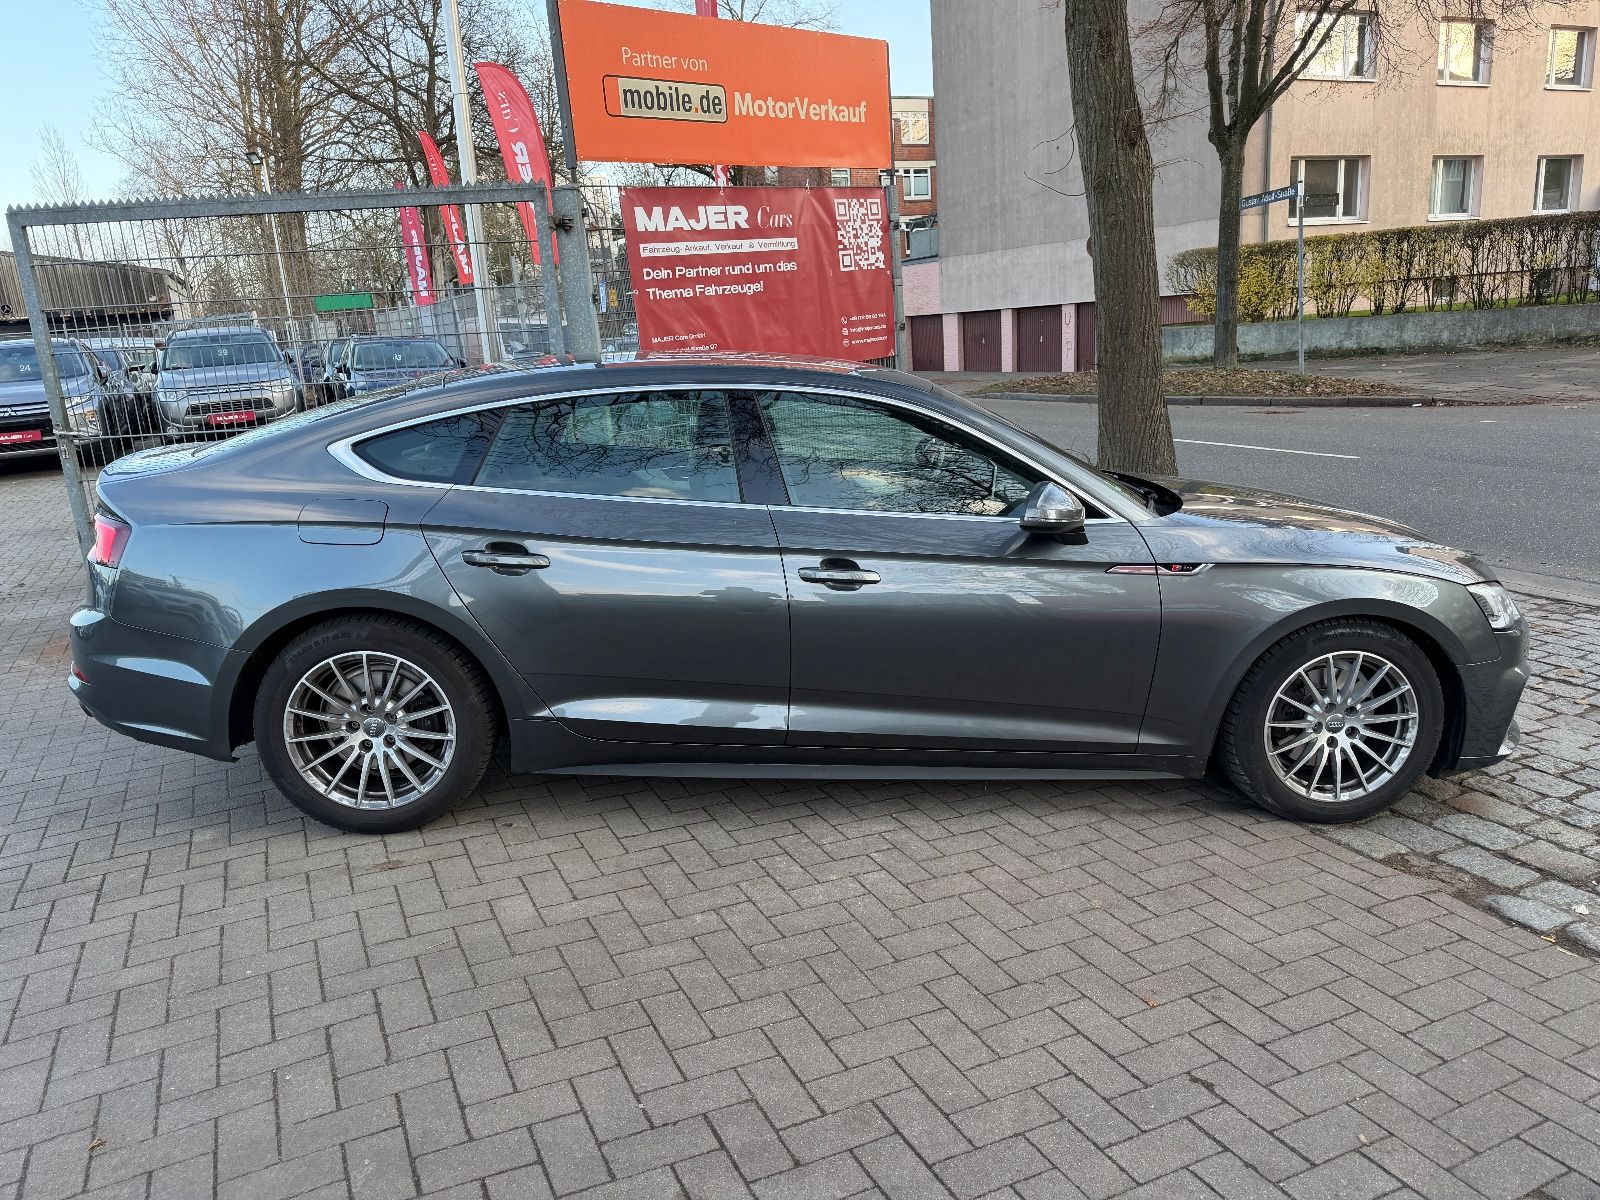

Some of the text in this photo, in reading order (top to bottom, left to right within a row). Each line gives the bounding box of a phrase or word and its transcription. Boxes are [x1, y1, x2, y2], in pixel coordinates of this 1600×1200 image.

[621, 47, 708, 72] Partner von
[623, 86, 867, 123] mobile.de MotorVerkauf
[634, 205, 793, 232] MAJER Cars
[714, 243, 743, 251] Verkauf
[642, 260, 797, 280] Dein Partner rund um das
[645, 281, 763, 300] Thema Fahrzeuge!
[217, 349, 228, 357] 39
[19, 364, 31, 373] 24
